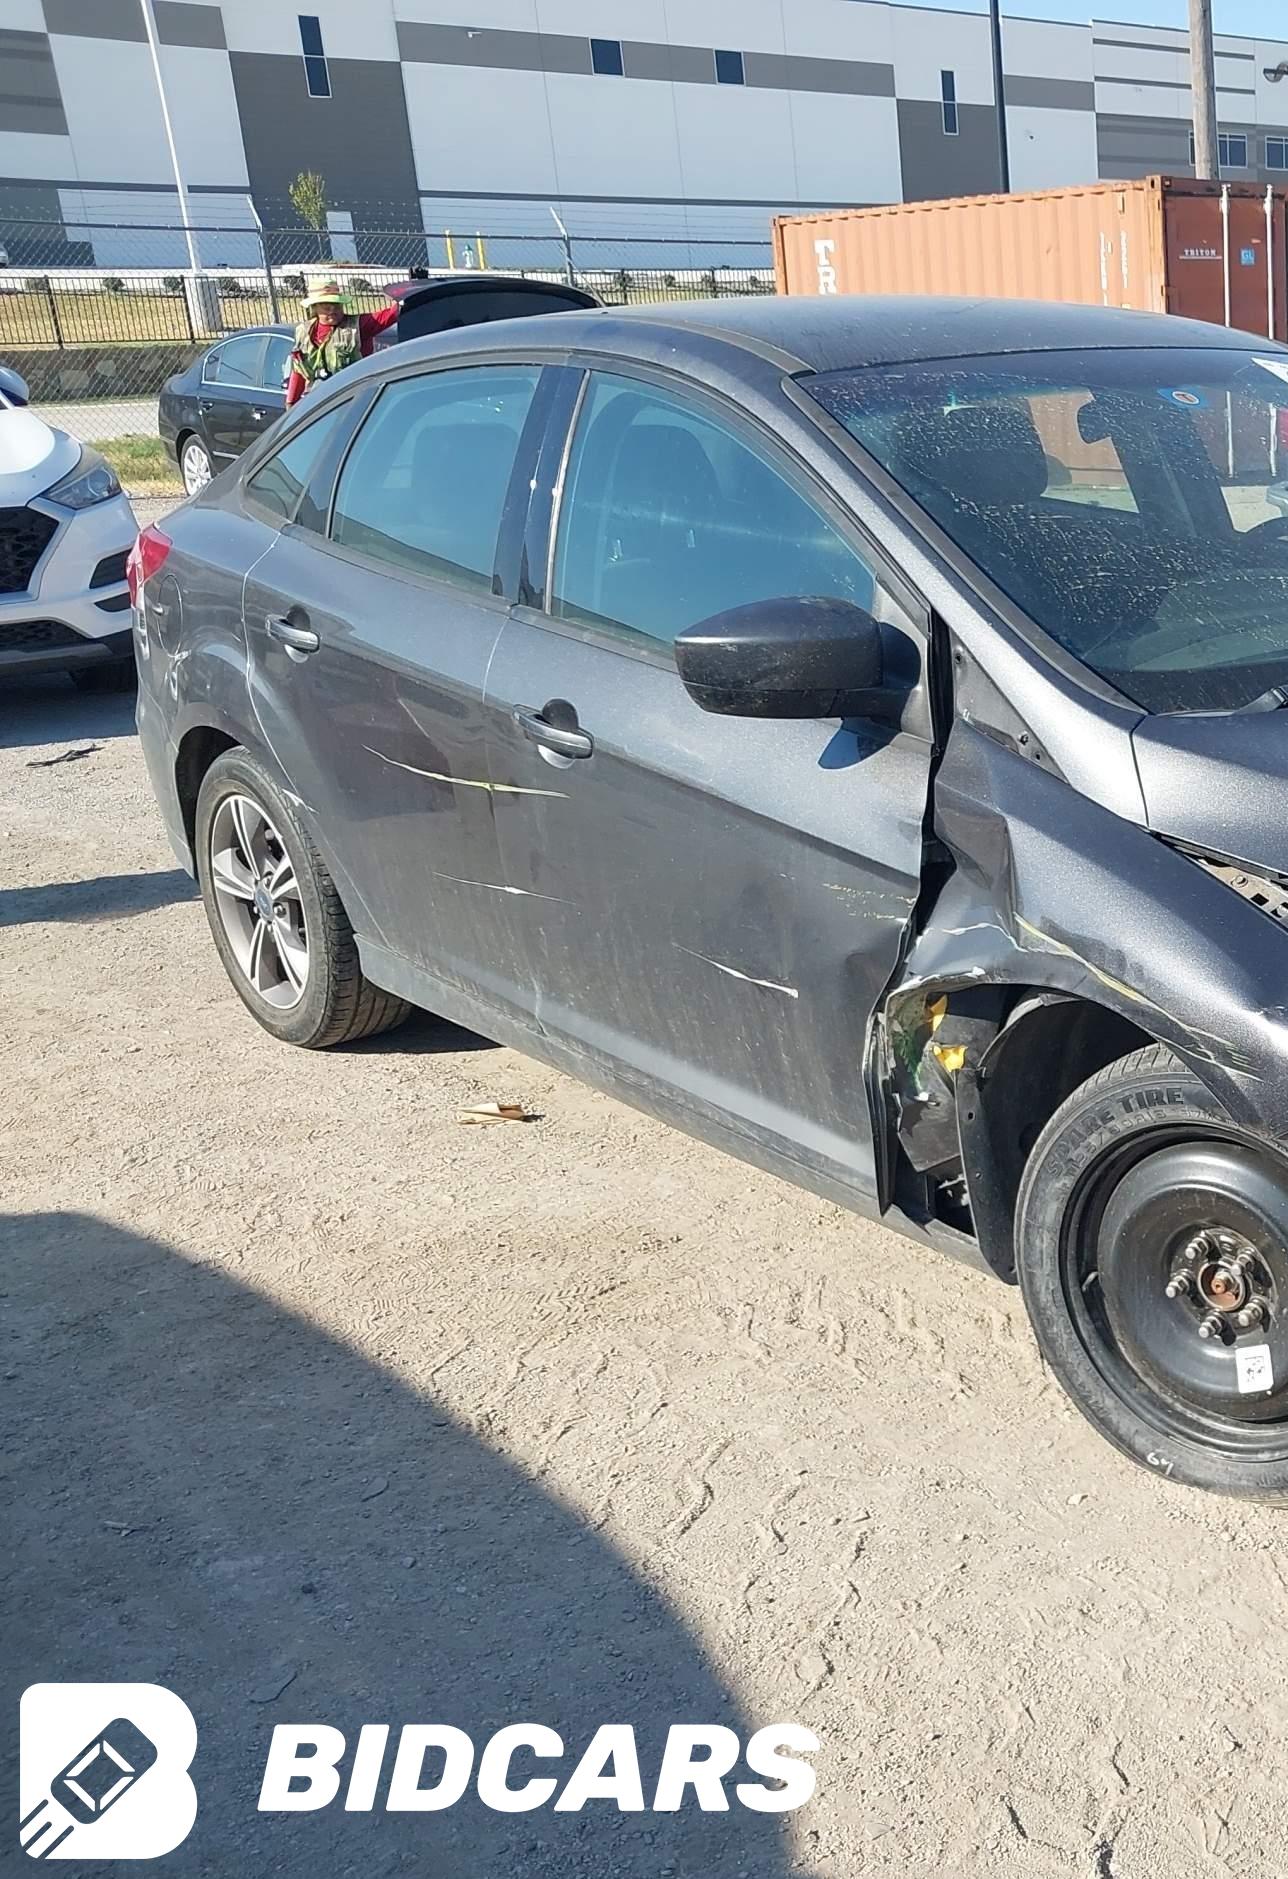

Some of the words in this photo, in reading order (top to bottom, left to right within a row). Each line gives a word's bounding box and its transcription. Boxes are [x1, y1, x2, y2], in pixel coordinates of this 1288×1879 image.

[1183, 249, 1216, 257] TRITON
[1048, 1108, 1116, 1178] SPARE
[1119, 1086, 1185, 1115] TIRE
